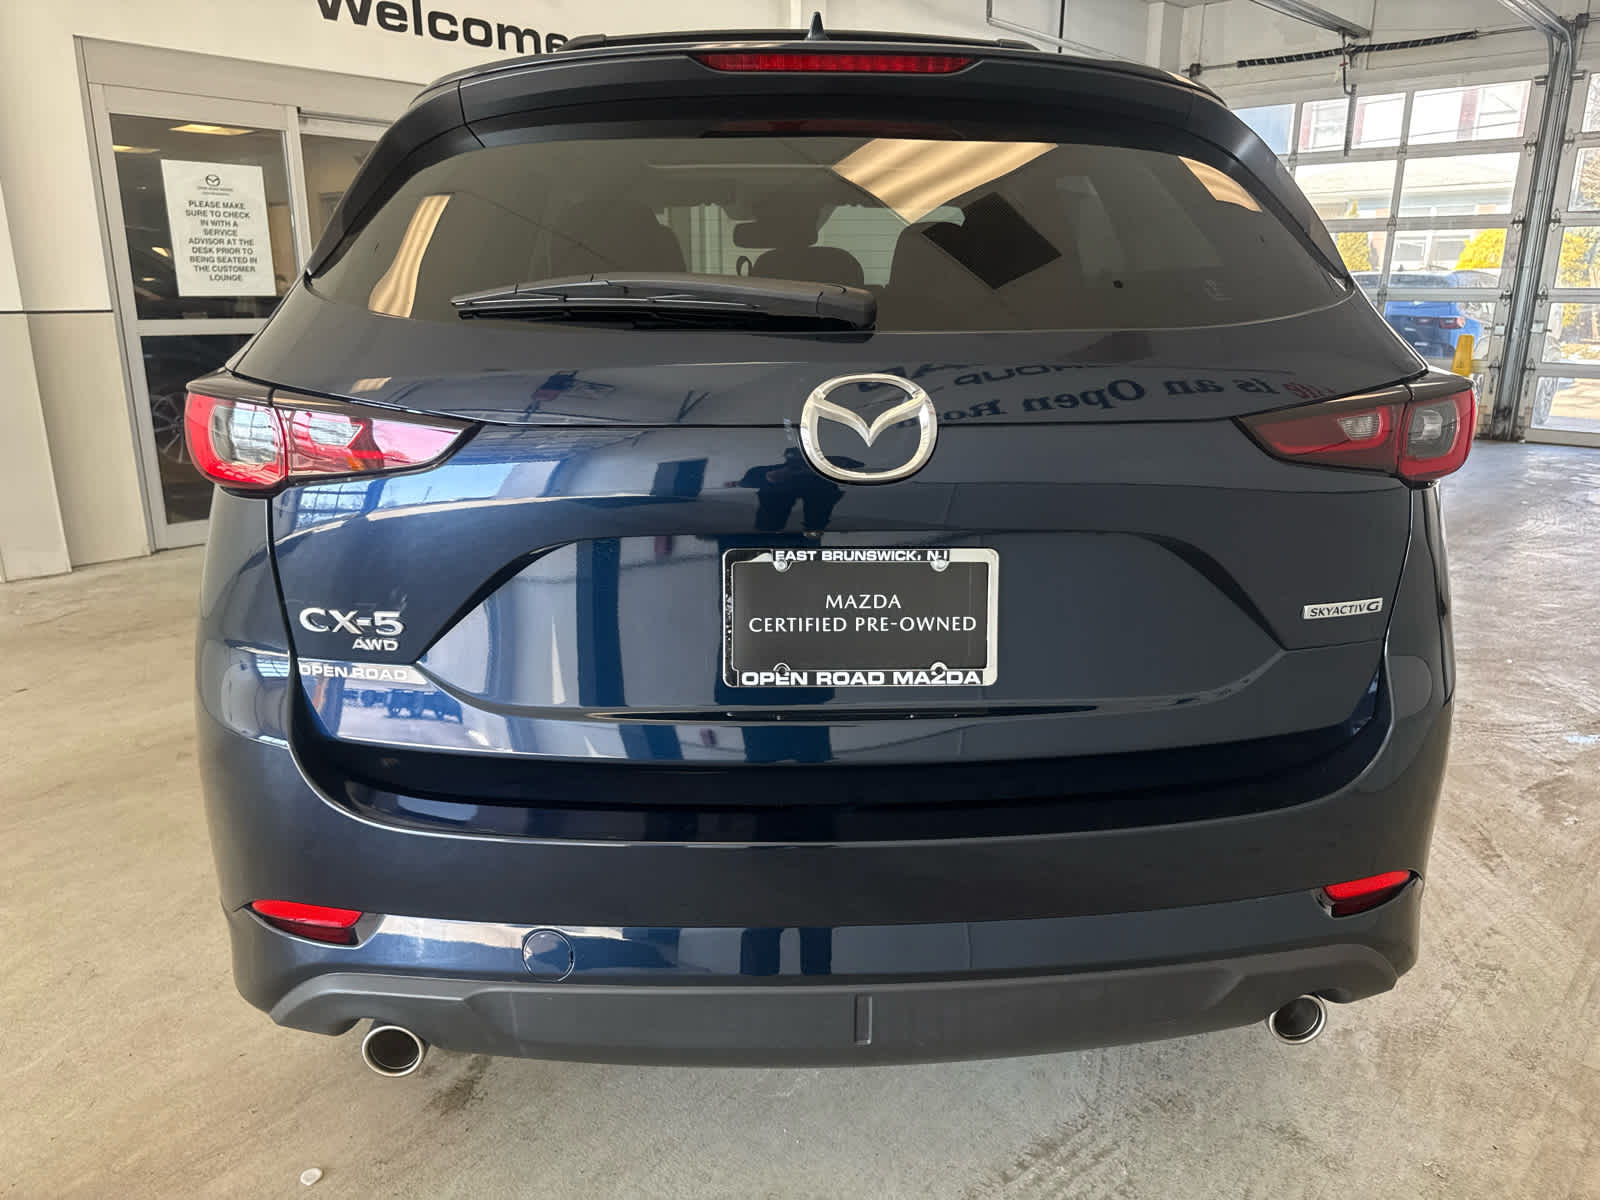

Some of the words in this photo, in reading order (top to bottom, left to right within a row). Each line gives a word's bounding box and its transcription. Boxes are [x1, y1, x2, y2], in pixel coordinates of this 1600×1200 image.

[188, 200, 220, 209] PLEASE
[222, 201, 246, 210] MAKE
[185, 209, 208, 217] SURE
[209, 210, 221, 218] TO
[222, 210, 250, 219] CHECK
[232, 220, 239, 228] A
[203, 228, 238, 237] SERVICE
[188, 238, 225, 246] ADVISOR
[226, 238, 237, 246] AT
[239, 238, 255, 246] THE
[191, 247, 214, 255] DESK
[216, 247, 240, 255] PRIOR
[242, 247, 253, 255] TO
[189, 256, 215, 264] BEING
[216, 256, 248, 264] SEATED
[249, 256, 258, 264] IN
[194, 265, 210, 273] THE
[211, 265, 256, 273] CUSTOMER
[209, 274, 243, 282] LOUNGE
[775, 550, 817, 562] EAST
[822, 550, 921, 562] BRUNSWICK,
[825, 594, 902, 610] MAZDA
[299, 607, 405, 637] CX-5
[748, 616, 847, 633] CERTIFIED
[855, 616, 977, 632] PRE-OWNED
[352, 638, 399, 652] AWD
[299, 663, 349, 679] OPEN
[350, 666, 409, 682] ROAD
[741, 671, 808, 686] OPEN
[816, 671, 885, 686] ROAD
[893, 670, 982, 685] MAZDA
